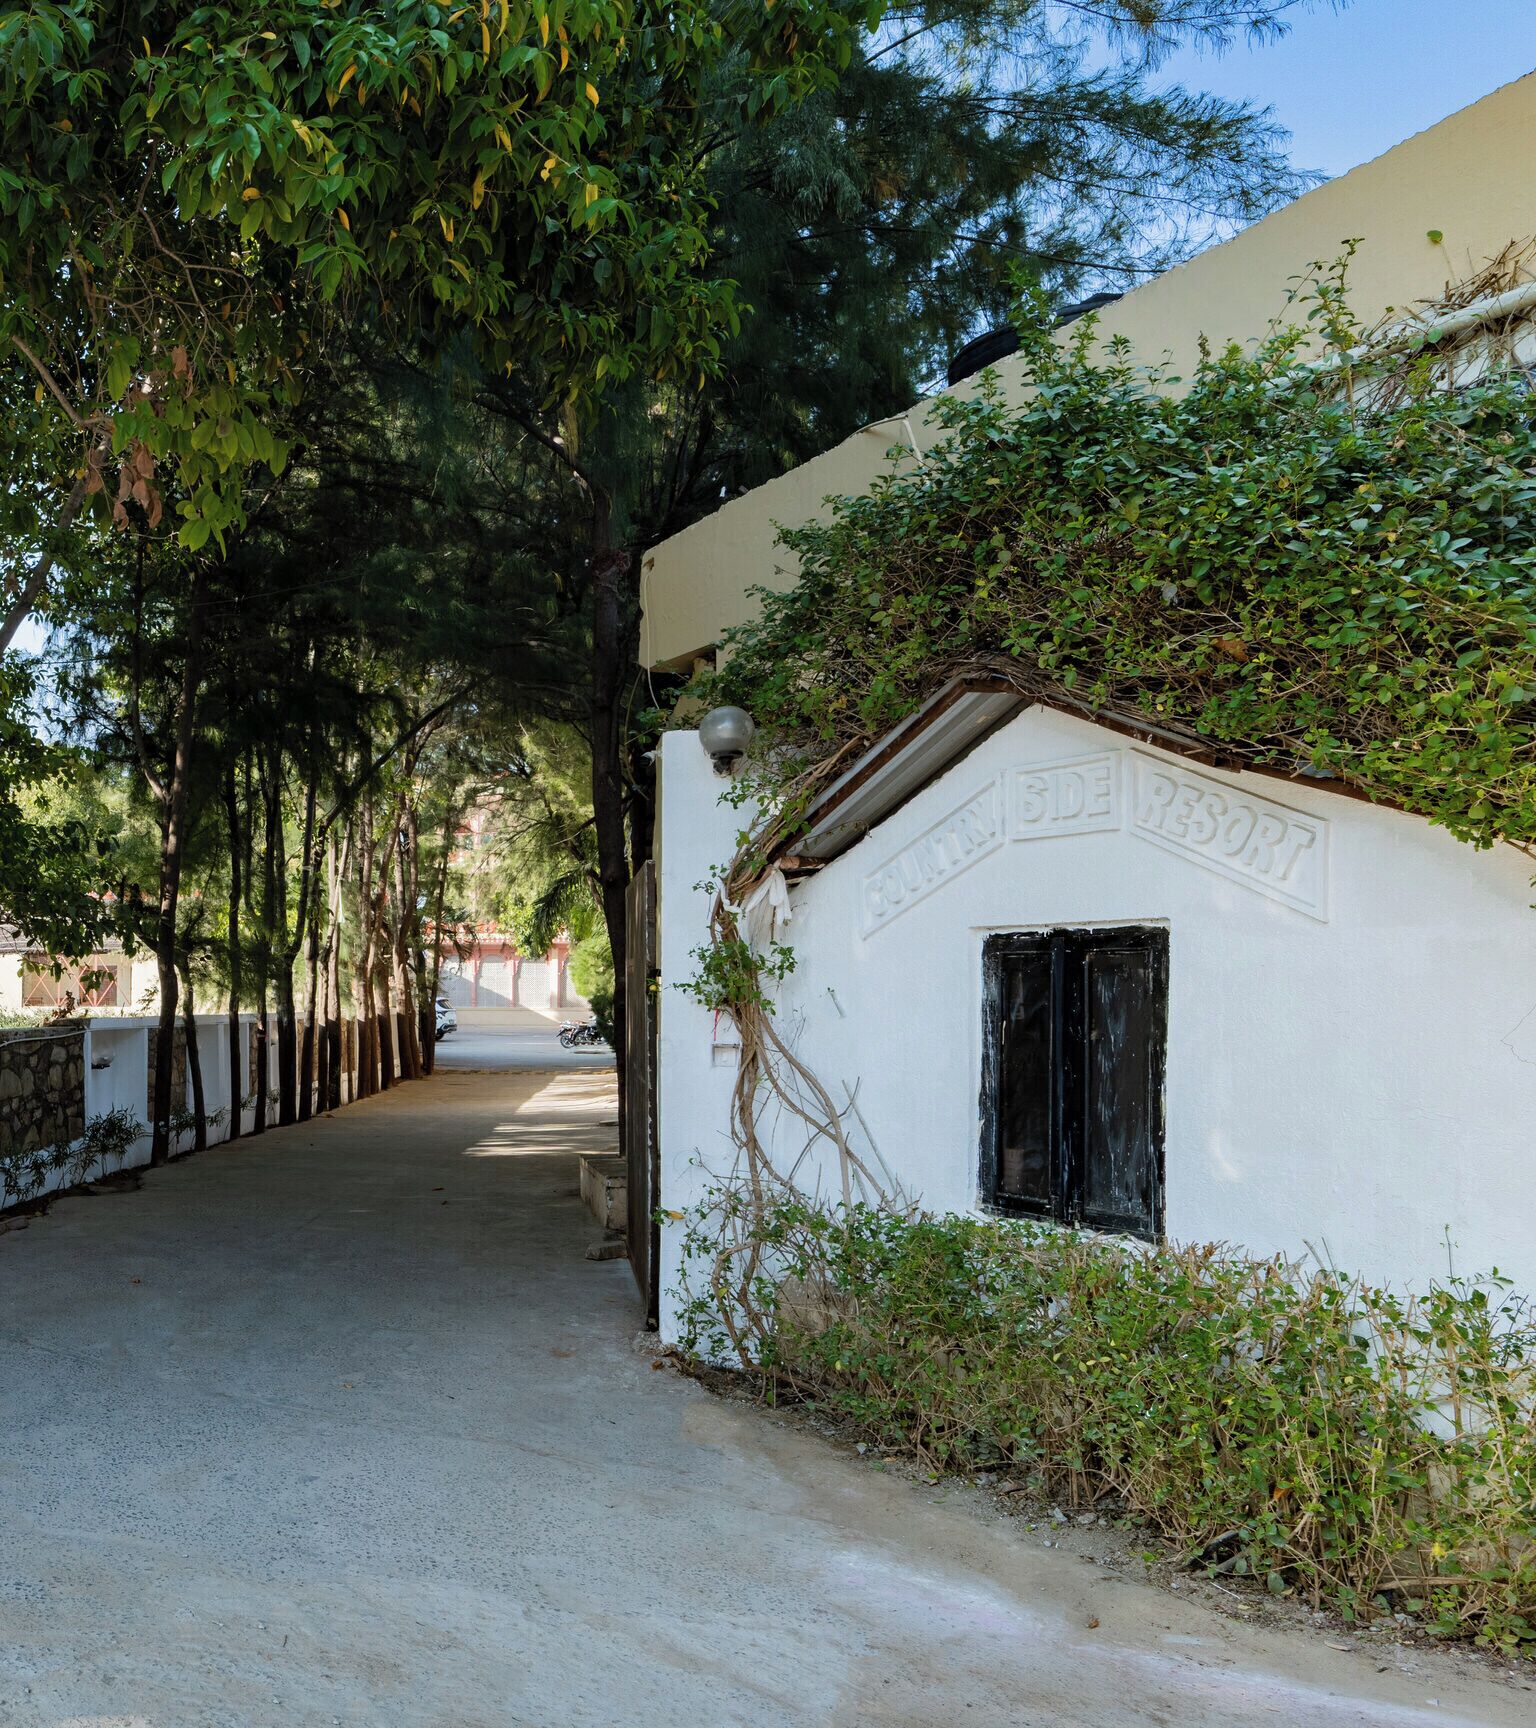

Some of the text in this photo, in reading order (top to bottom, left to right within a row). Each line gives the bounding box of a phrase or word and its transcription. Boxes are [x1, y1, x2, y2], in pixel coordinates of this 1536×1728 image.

[866, 766, 1317, 917] COUNTRY SIDE RESORT
